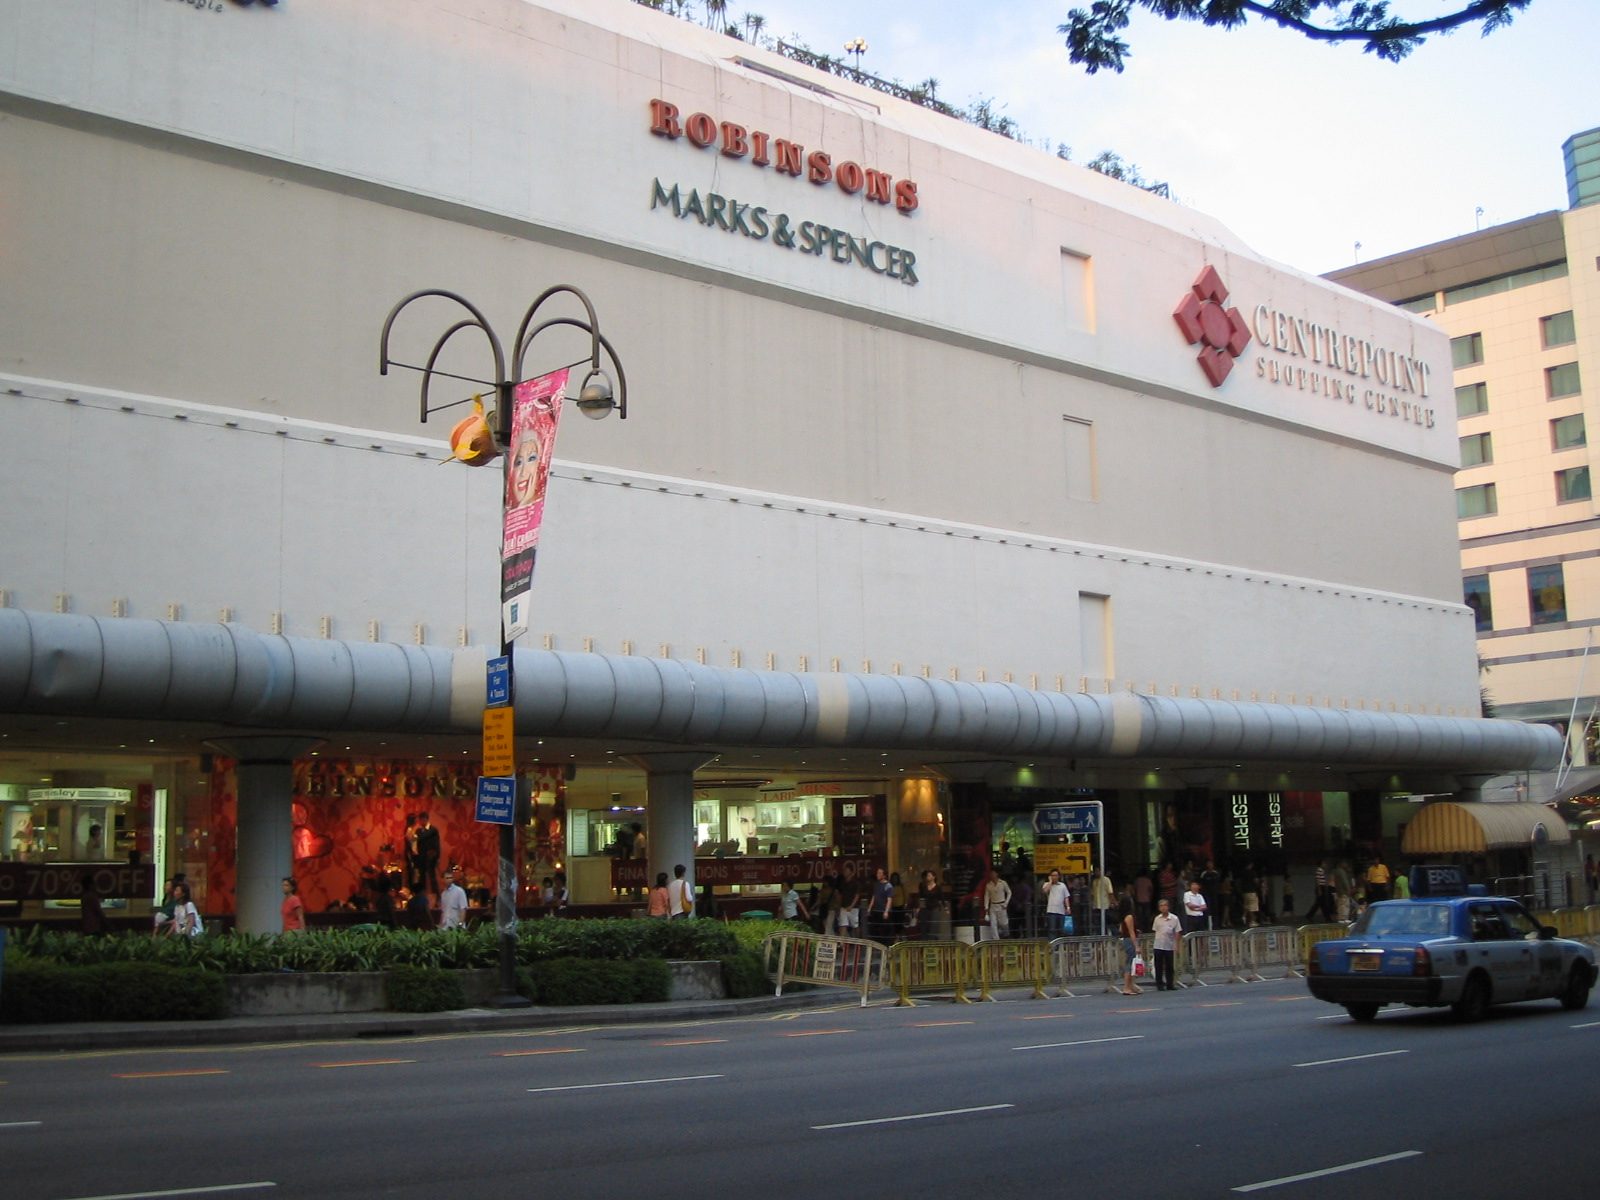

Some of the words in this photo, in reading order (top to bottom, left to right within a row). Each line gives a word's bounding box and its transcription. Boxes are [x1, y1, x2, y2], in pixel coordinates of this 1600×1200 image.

[650, 98, 919, 212] ROBINSONS
[651, 176, 769, 239] MARKS
[799, 220, 920, 285] SPENCER
[1253, 303, 1431, 398] CENTREPOINT
[1257, 356, 1355, 404] SHOPPING
[1364, 389, 1435, 428] CENTRE
[1232, 794, 1250, 849] ESPRIT
[1268, 793, 1284, 848] ESPRIT
[26, 870, 83, 895] 70%
[94, 870, 145, 895] OFF
[619, 866, 647, 881] FINA
[806, 860, 839, 879] 70%
